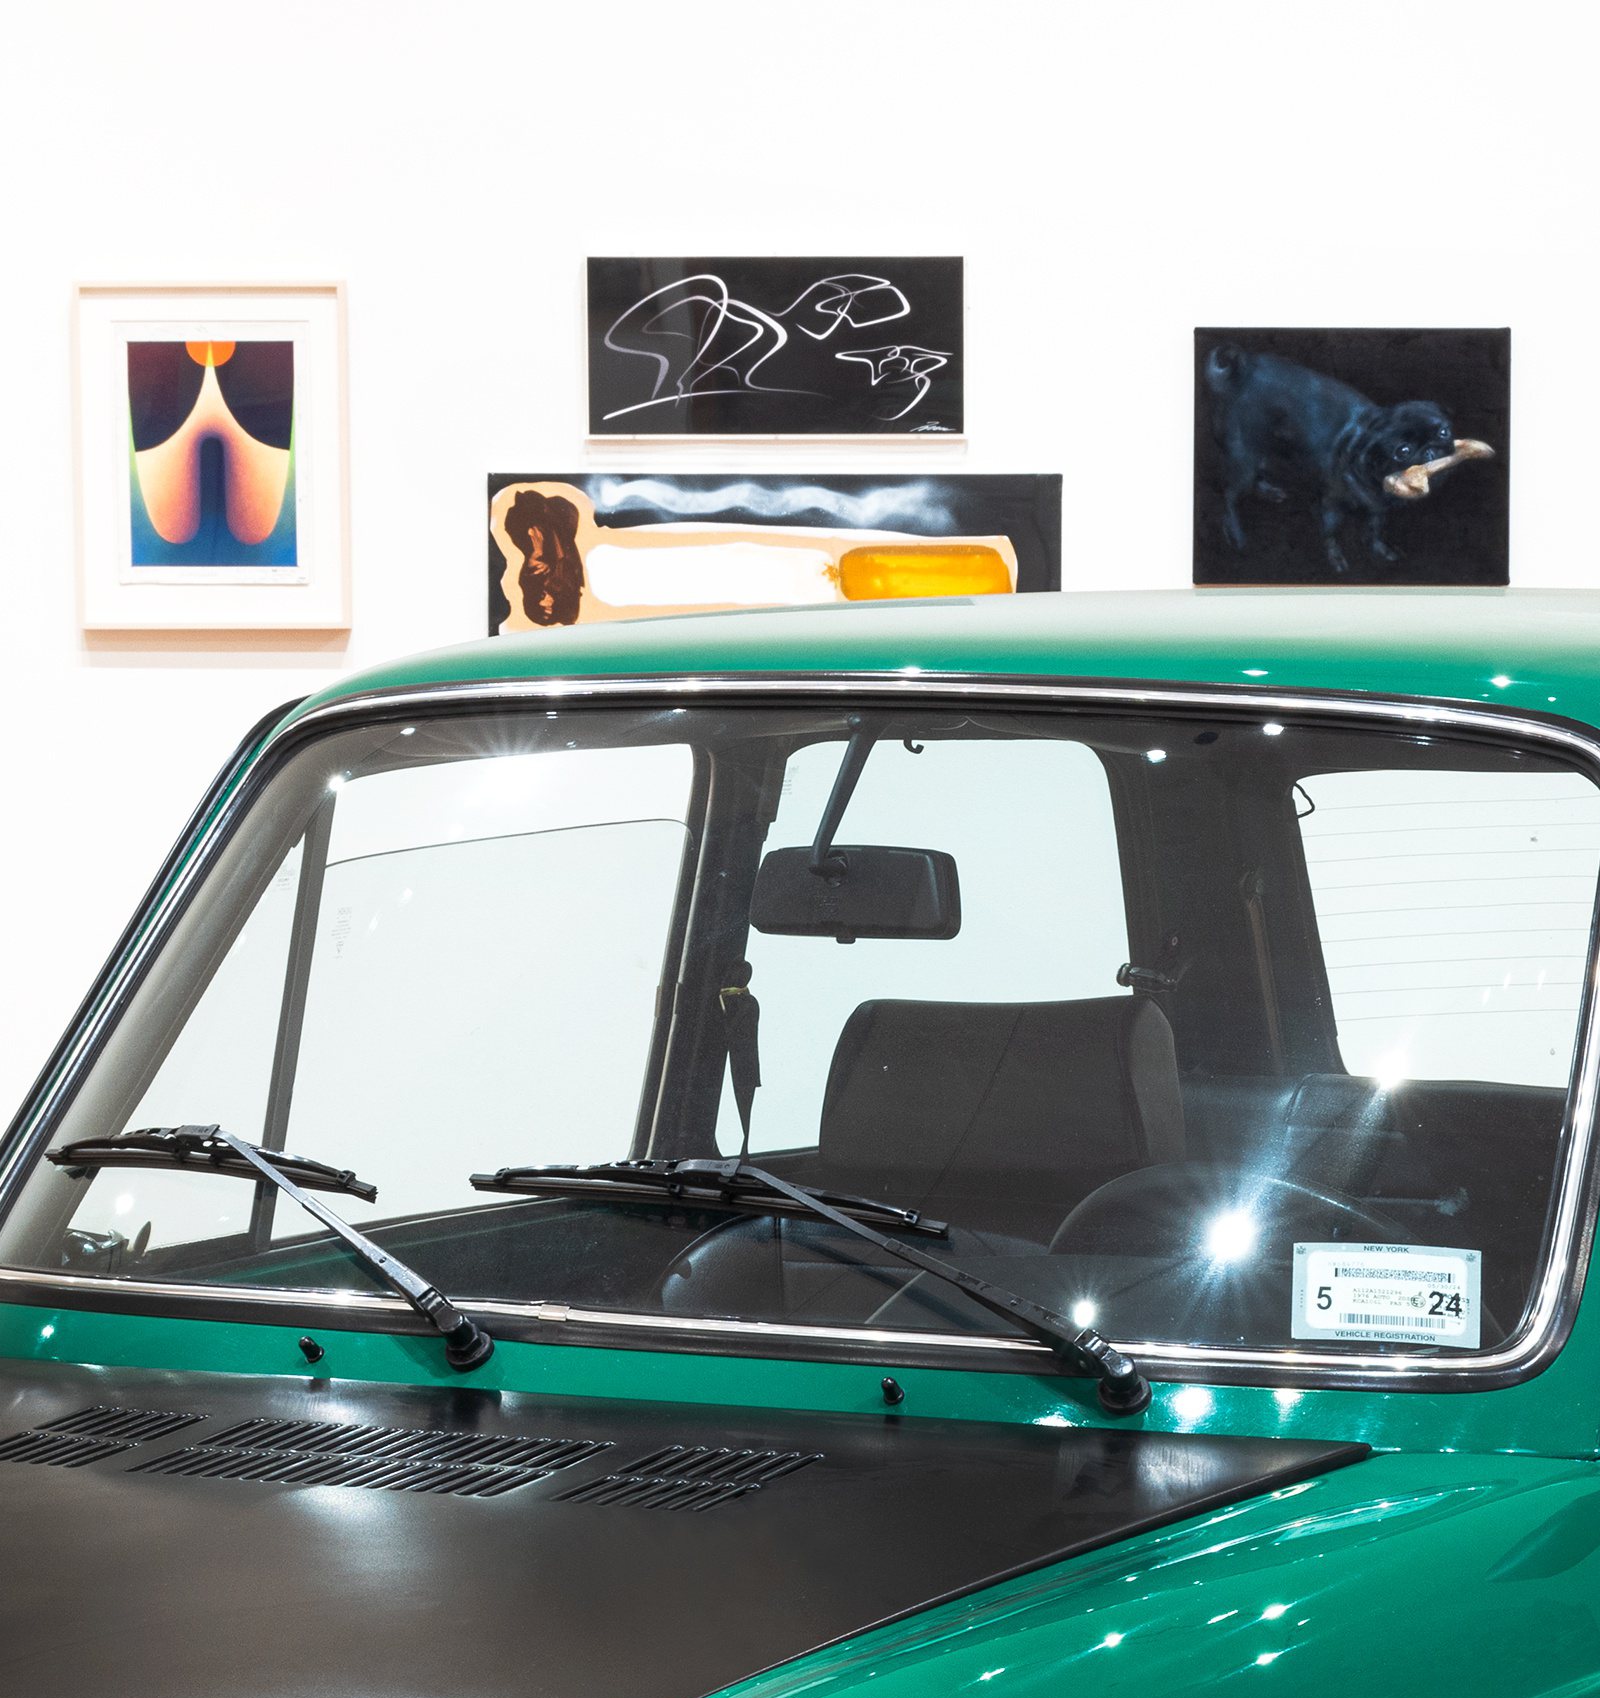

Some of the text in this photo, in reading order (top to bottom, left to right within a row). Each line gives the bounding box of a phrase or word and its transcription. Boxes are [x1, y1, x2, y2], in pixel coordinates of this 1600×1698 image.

[1316, 1286, 1332, 1310] 5
[1428, 1290, 1462, 1317] 24
[1334, 1330, 1436, 1341] VEHICLE REGISTRATION
